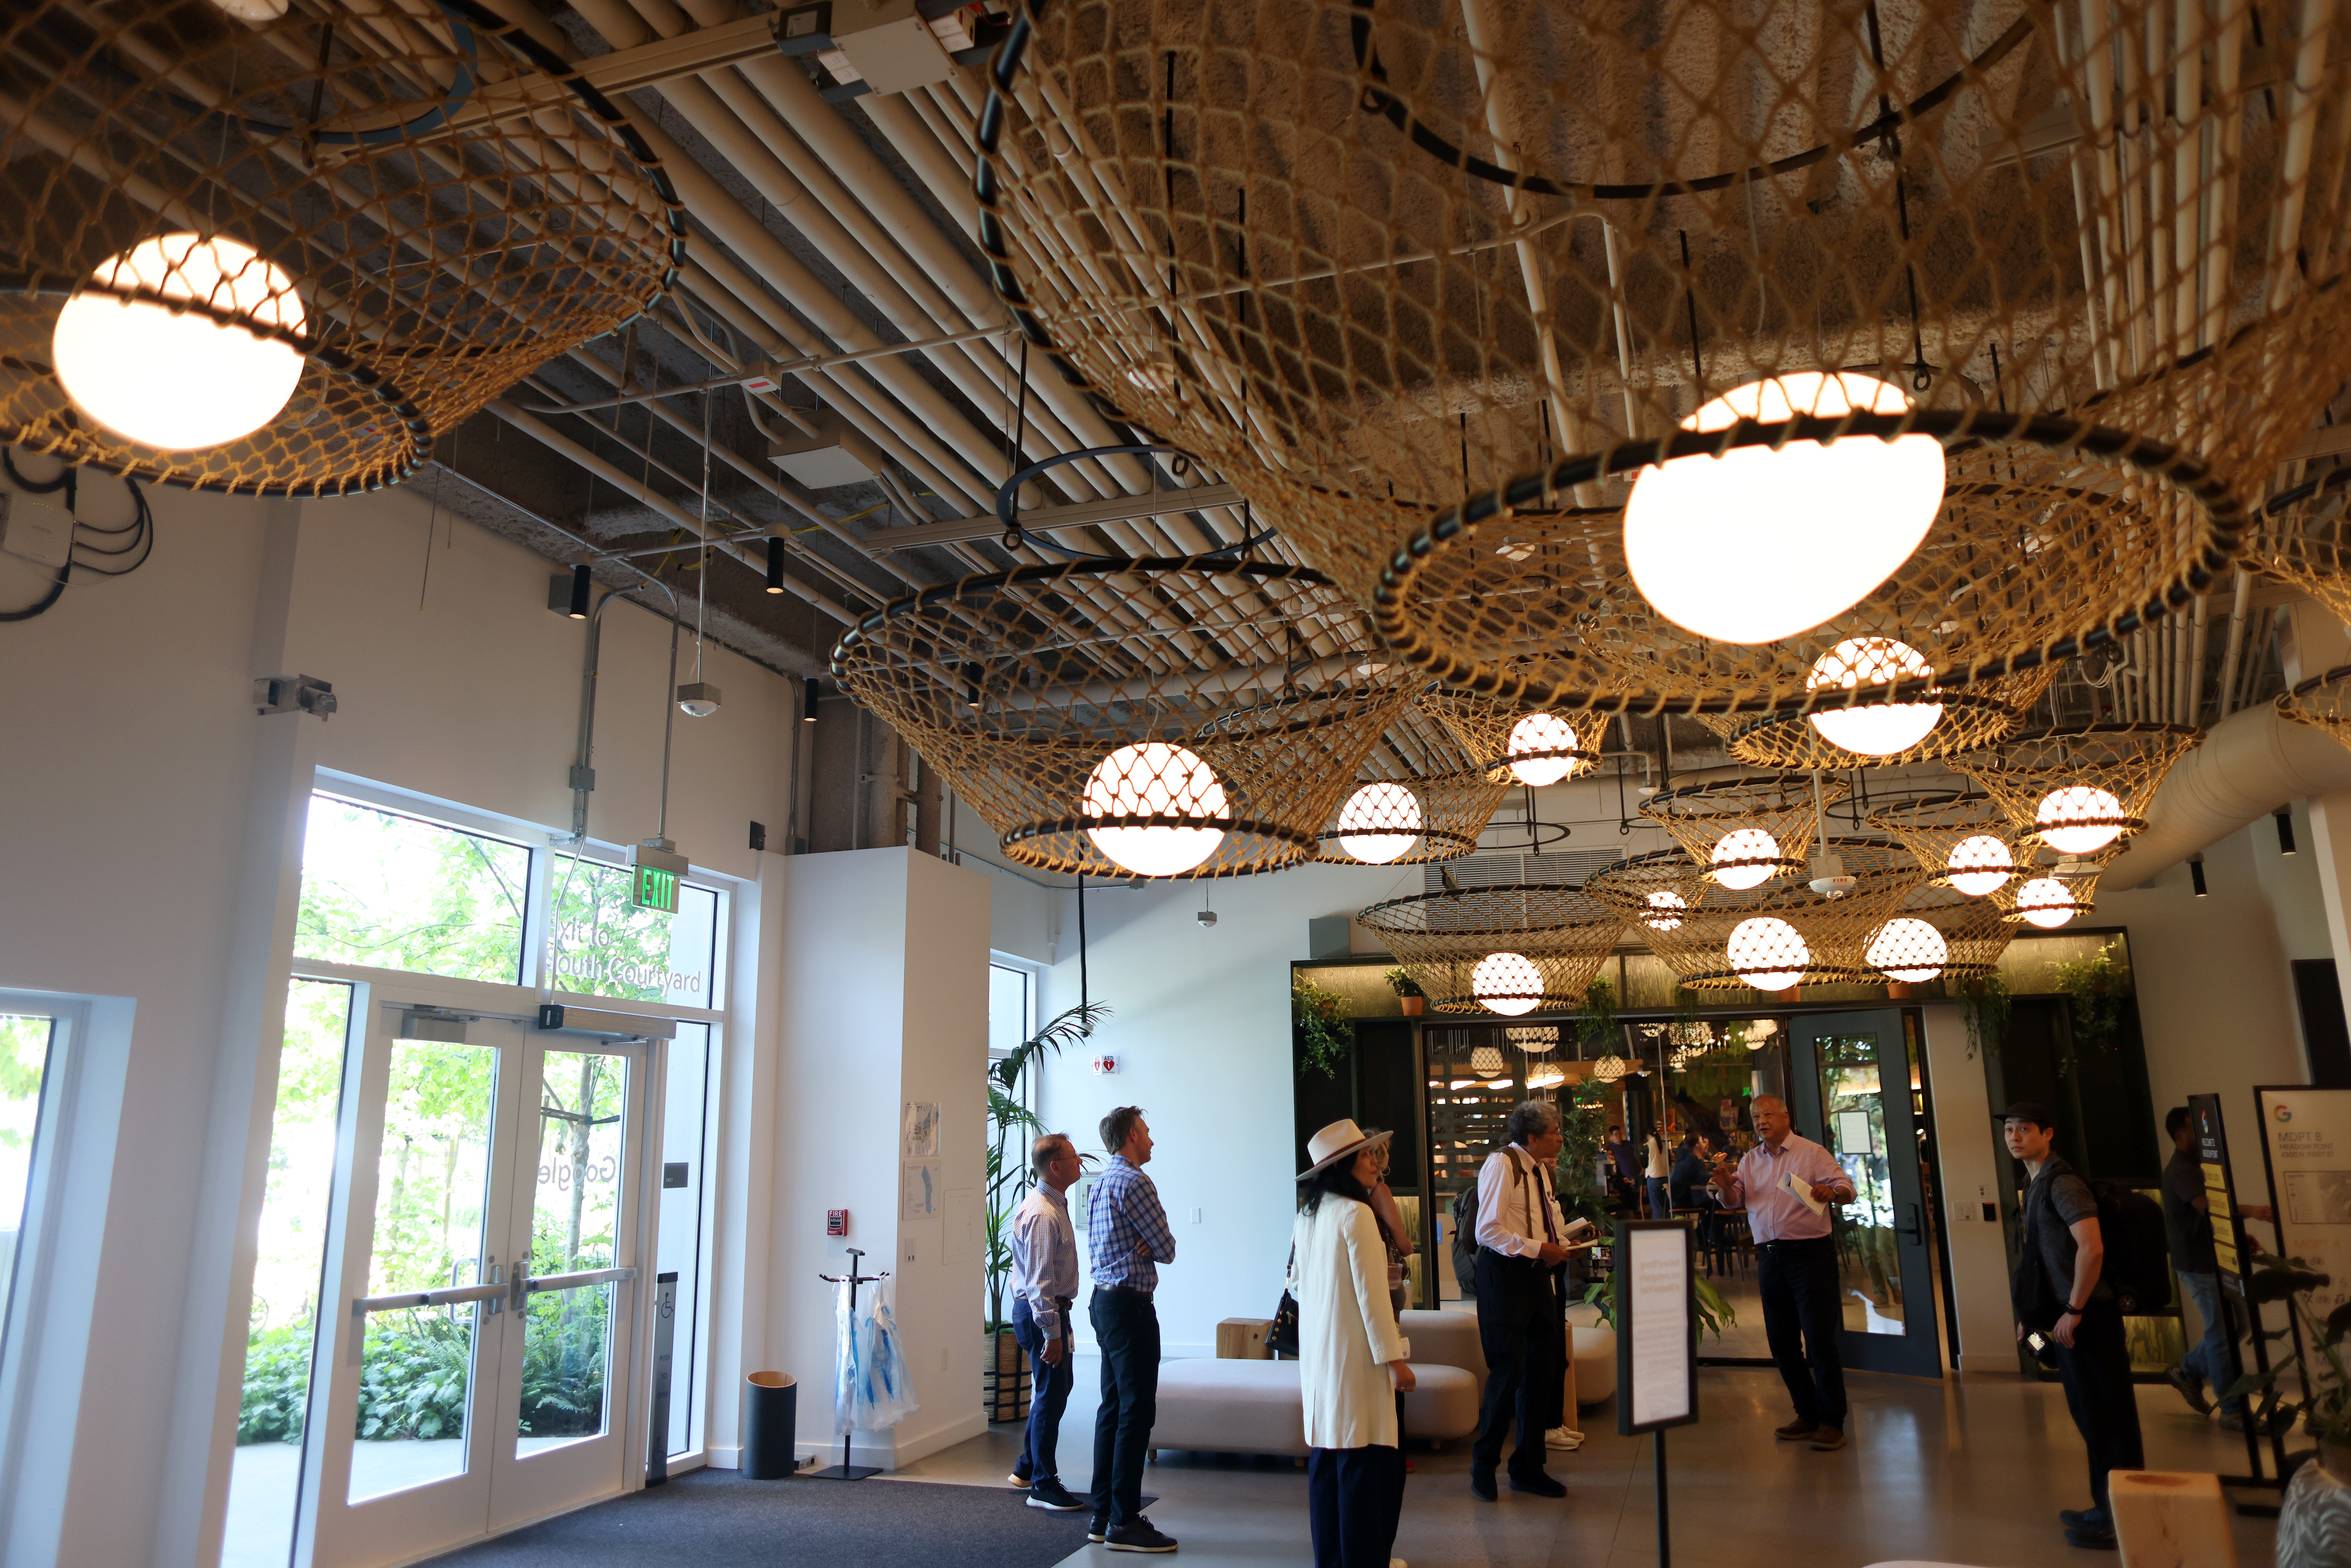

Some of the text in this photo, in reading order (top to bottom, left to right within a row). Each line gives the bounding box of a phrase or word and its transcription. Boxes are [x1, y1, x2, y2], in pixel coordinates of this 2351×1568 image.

[642, 868, 674, 910] EXIT
[591, 922, 610, 947] to
[610, 956, 701, 995] Courtyard
[2279, 1132, 2322, 1142] MDPT 8
